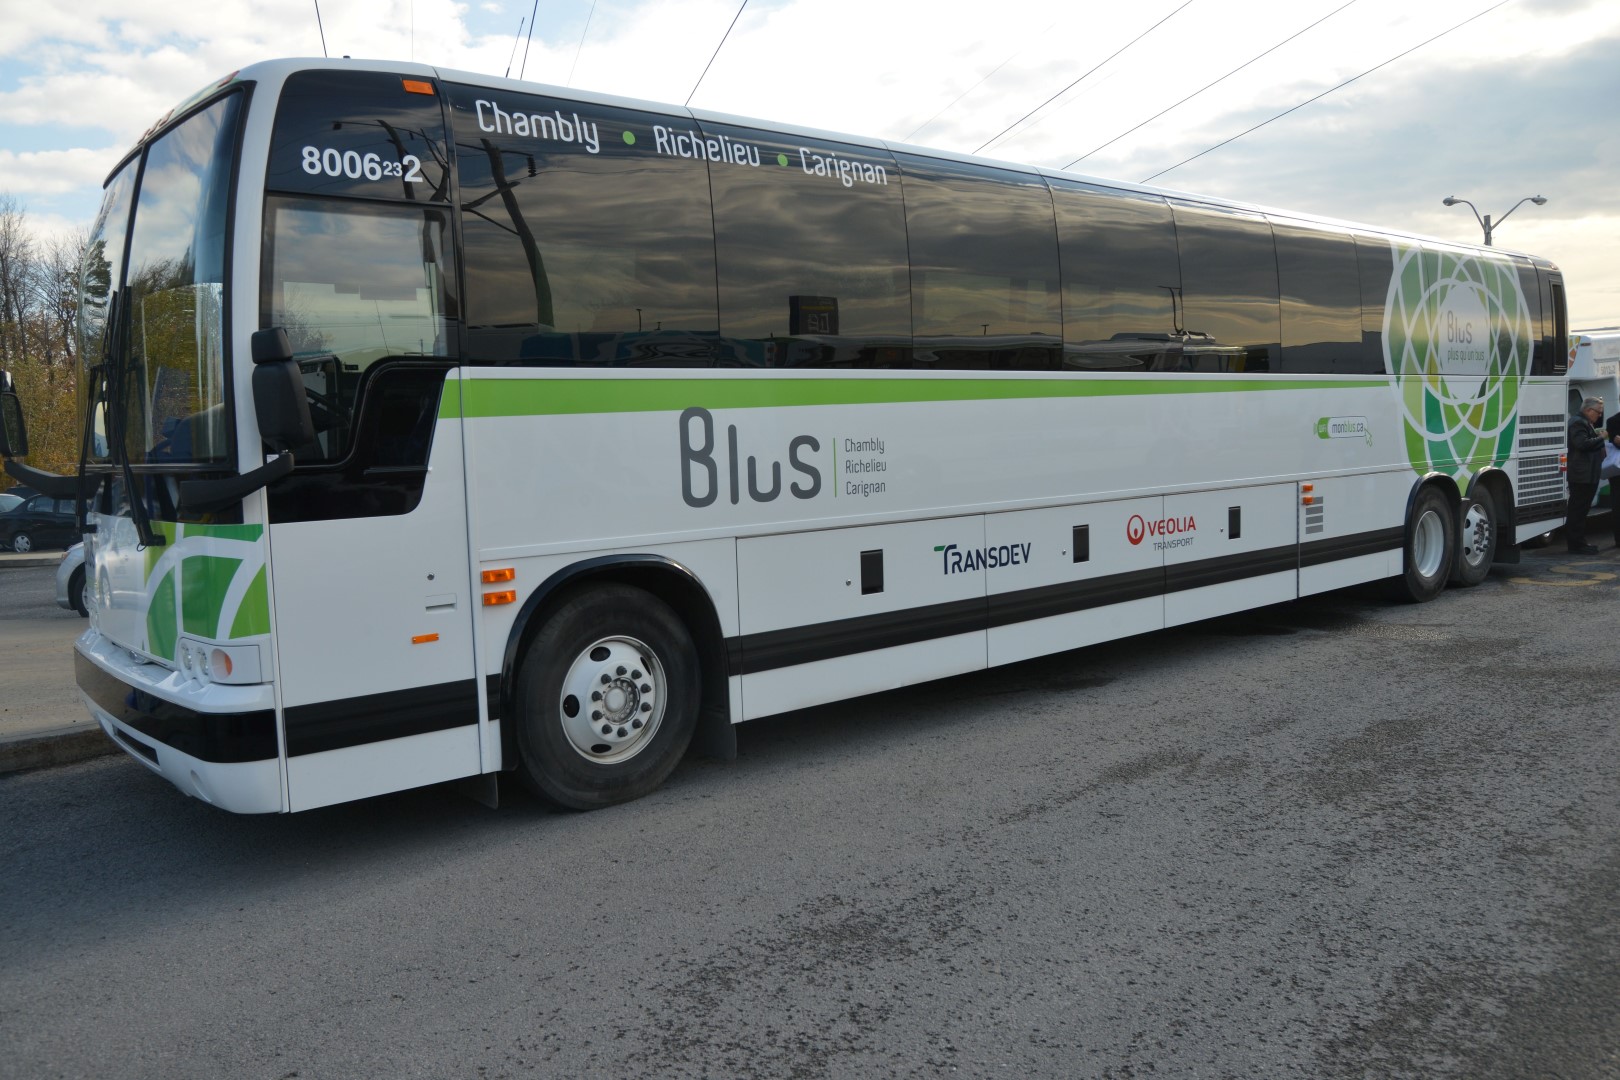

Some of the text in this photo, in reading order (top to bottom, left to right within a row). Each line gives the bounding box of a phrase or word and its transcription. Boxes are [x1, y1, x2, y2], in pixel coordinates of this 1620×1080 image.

[475, 99, 888, 188] Chambly Richelieu Carignan
[1447, 309, 1473, 345] Blus
[844, 437, 885, 455] Chambly
[678, 406, 822, 509] Blus
[845, 459, 887, 474] Richelieu
[846, 480, 886, 498] Carignan
[1148, 515, 1197, 537] VEOLIA
[1153, 536, 1194, 552] TRANSPORT
[934, 542, 1031, 575] TRANSDEV
